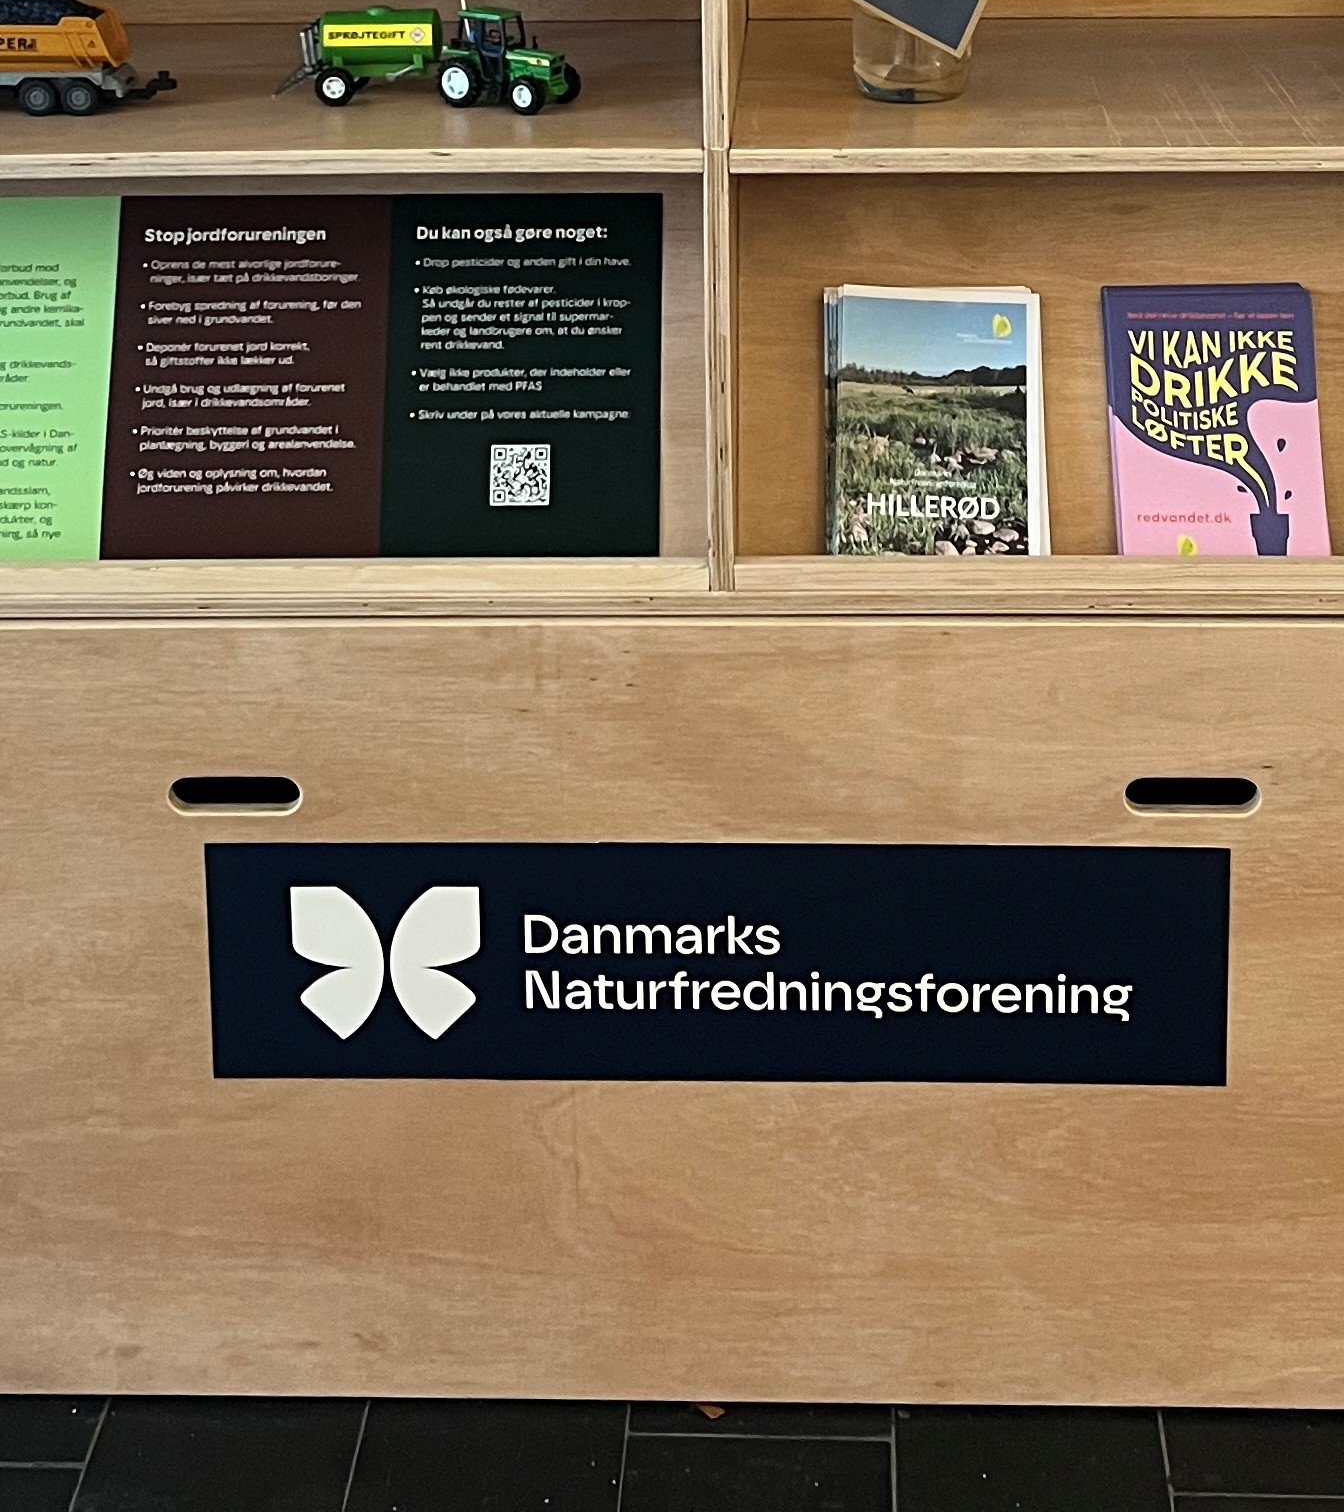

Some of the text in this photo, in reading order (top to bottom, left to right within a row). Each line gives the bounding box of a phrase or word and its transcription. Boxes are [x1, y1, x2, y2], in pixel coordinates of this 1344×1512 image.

[327, 30, 406, 41] SPRØJTEGIFT
[144, 226, 327, 246] Stop jordforureningen
[416, 223, 608, 243] Du kan også gøre noget:
[1127, 330, 1295, 369] VI KAN IKKE
[1129, 351, 1300, 408] DRIKKE
[1129, 389, 1240, 429] POLITISKE
[1130, 420, 1251, 464] LØFTER
[864, 493, 1002, 521] HILLERØD
[1136, 511, 1232, 524] redvandet.dk
[523, 914, 781, 956] Danmarks
[525, 969, 1133, 1022] Naturfredningsforening
